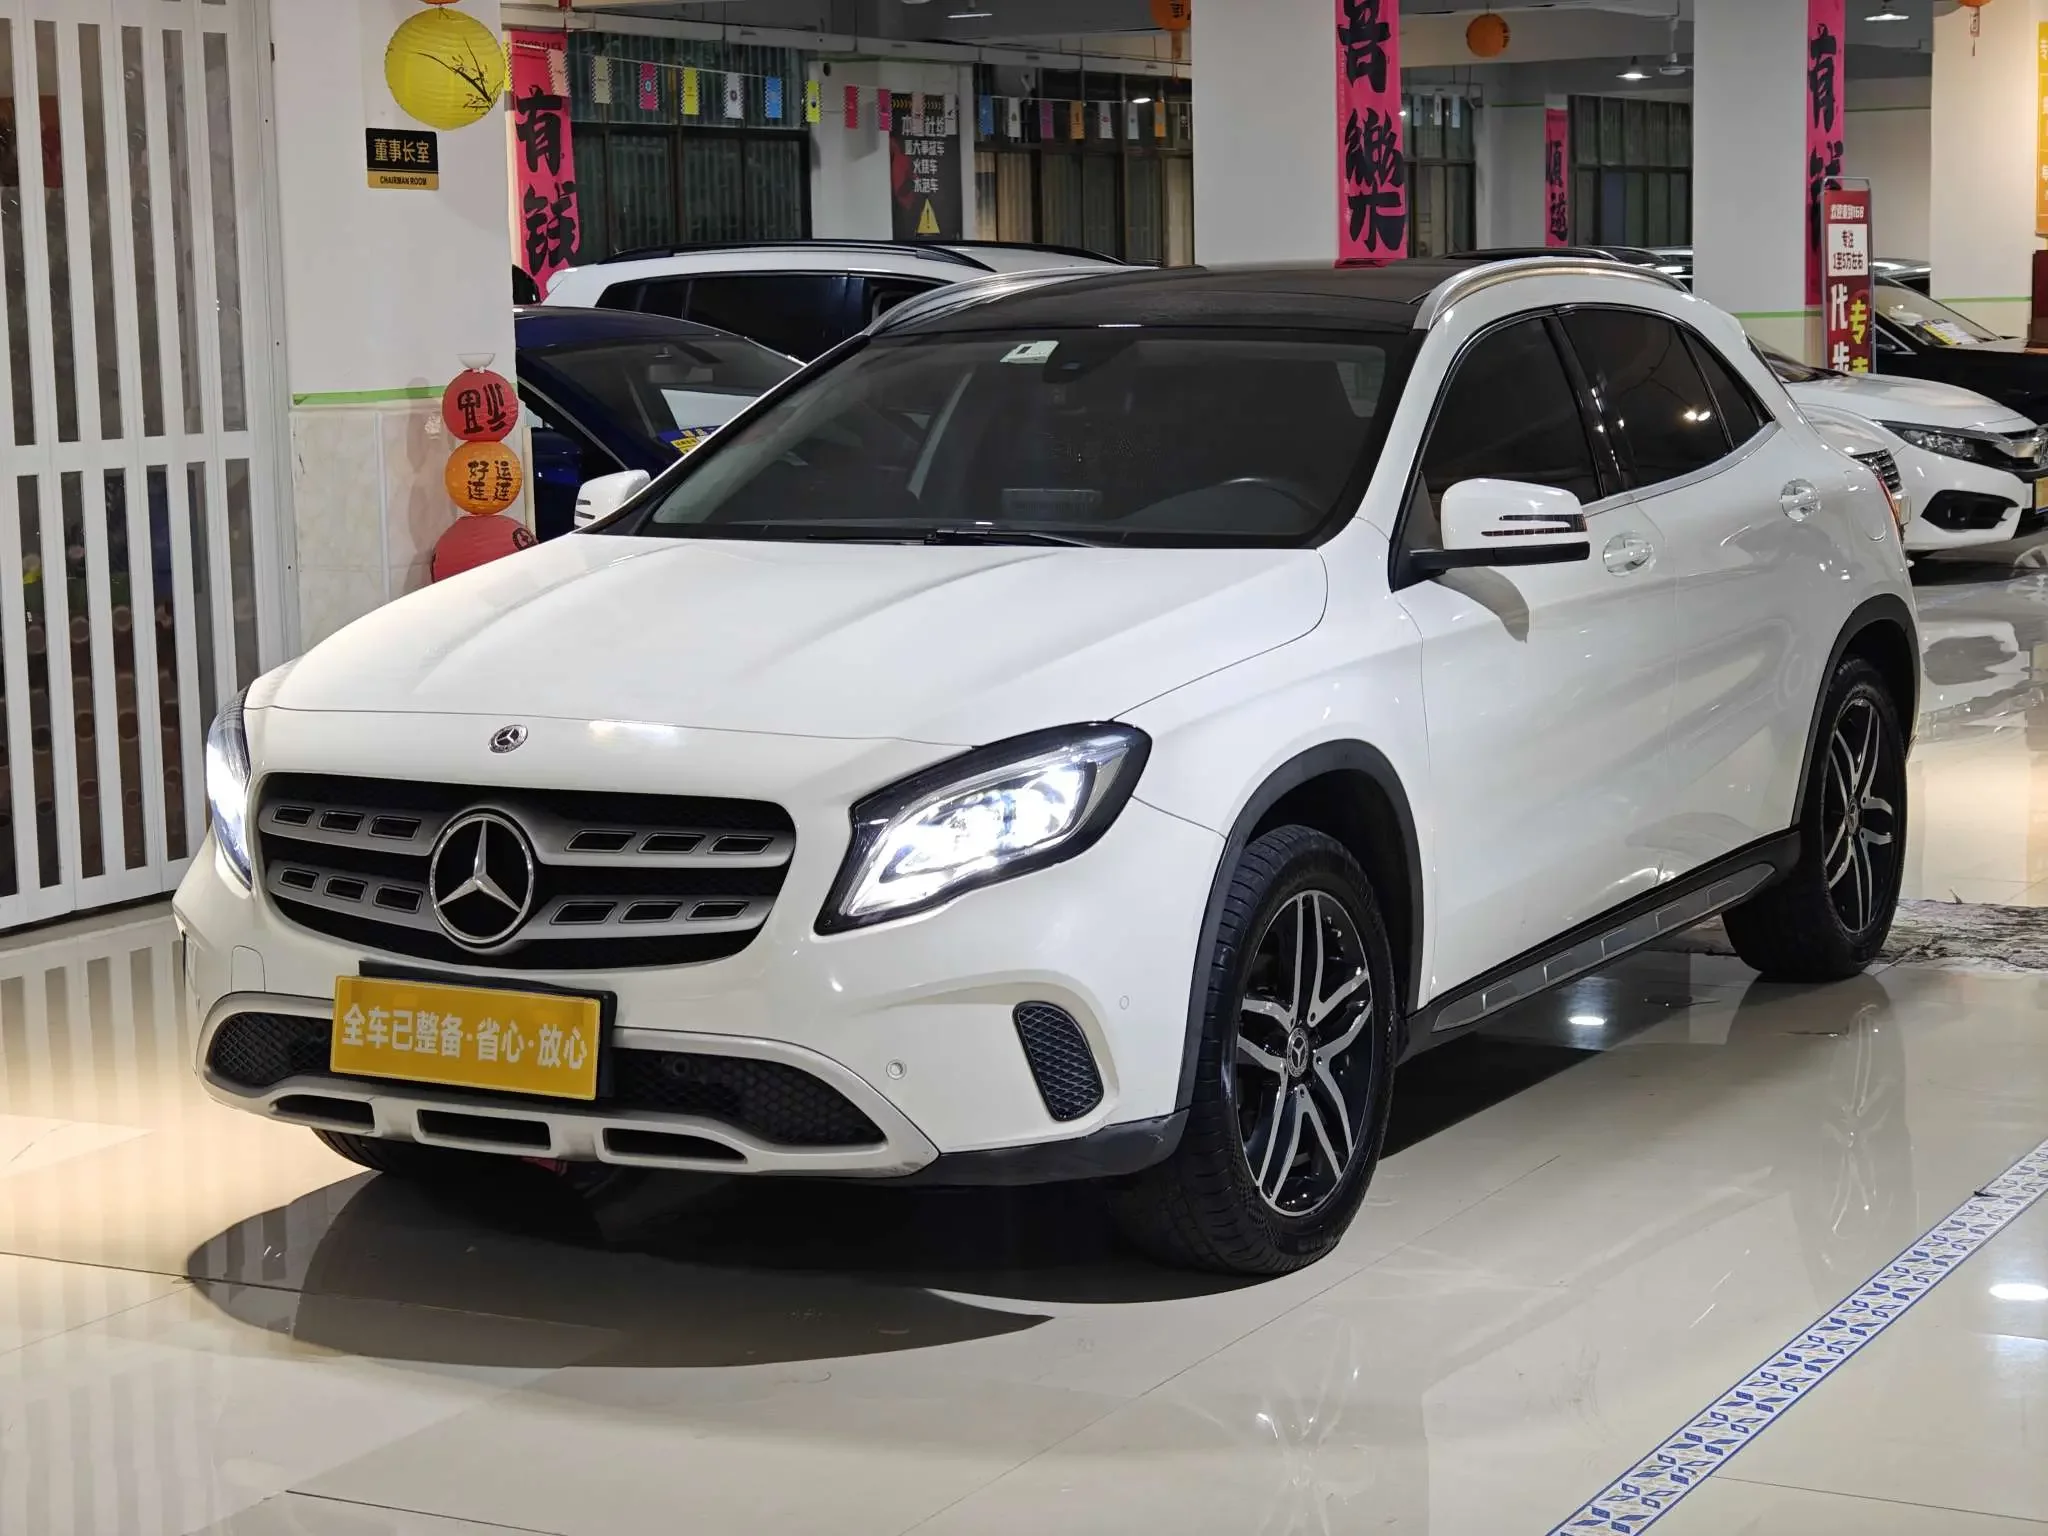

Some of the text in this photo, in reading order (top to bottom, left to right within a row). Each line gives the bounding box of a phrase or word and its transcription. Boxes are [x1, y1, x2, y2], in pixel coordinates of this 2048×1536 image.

[374, 138, 431, 163] 董事长室
[380, 175, 427, 186] CHAIRMAN ROOM
[457, 383, 506, 435] 福
